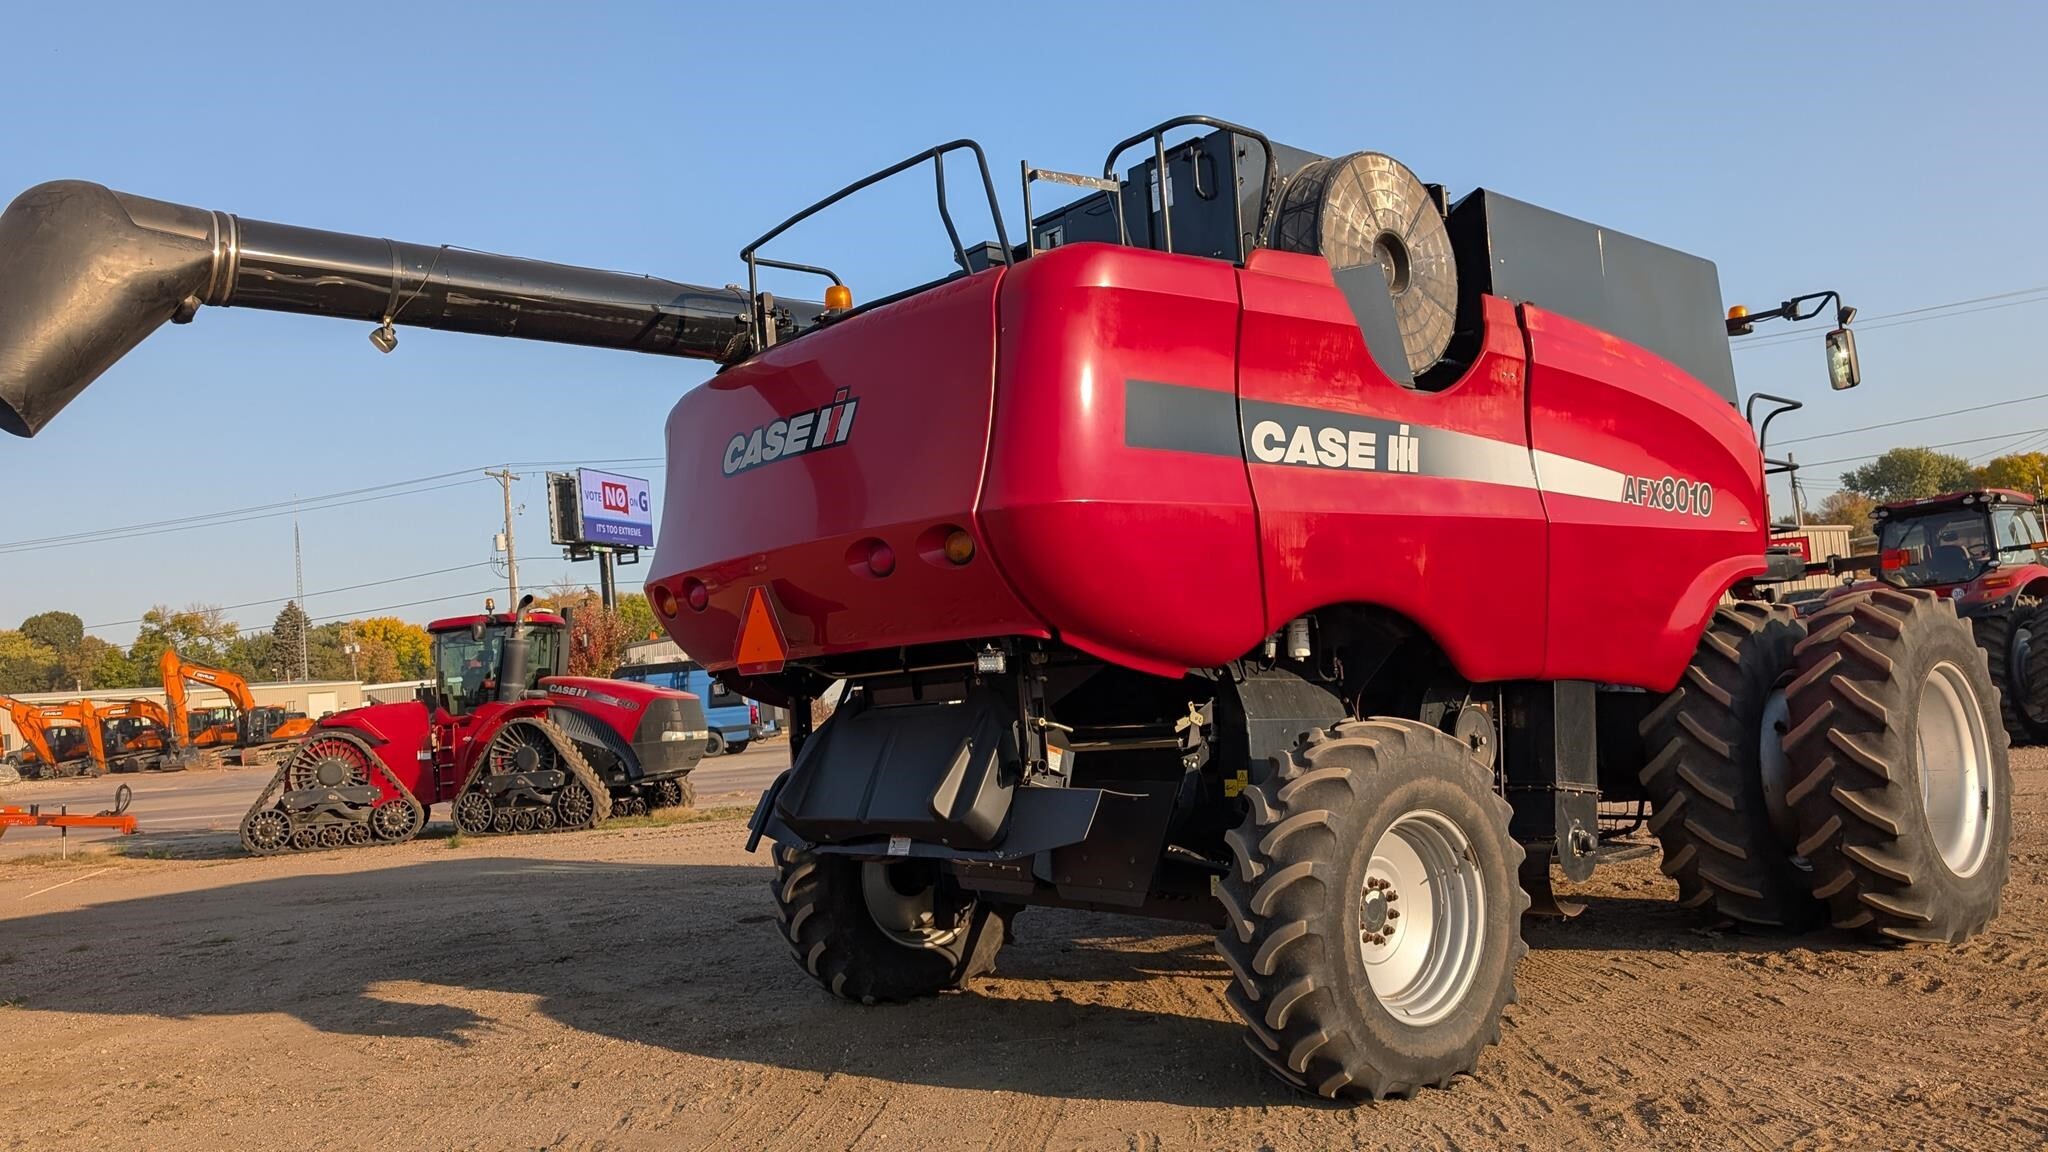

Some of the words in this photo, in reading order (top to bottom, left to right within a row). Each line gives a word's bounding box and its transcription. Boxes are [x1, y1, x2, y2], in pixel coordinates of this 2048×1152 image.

[724, 412, 815, 474] CASE
[1251, 420, 1376, 470] CASE
[585, 490, 602, 502] VOTE
[639, 491, 648, 512] G
[1622, 475, 1713, 517] AFX8010
[596, 524, 606, 533] IT'S
[606, 525, 618, 535] TOO
[549, 684, 577, 695] CASE
